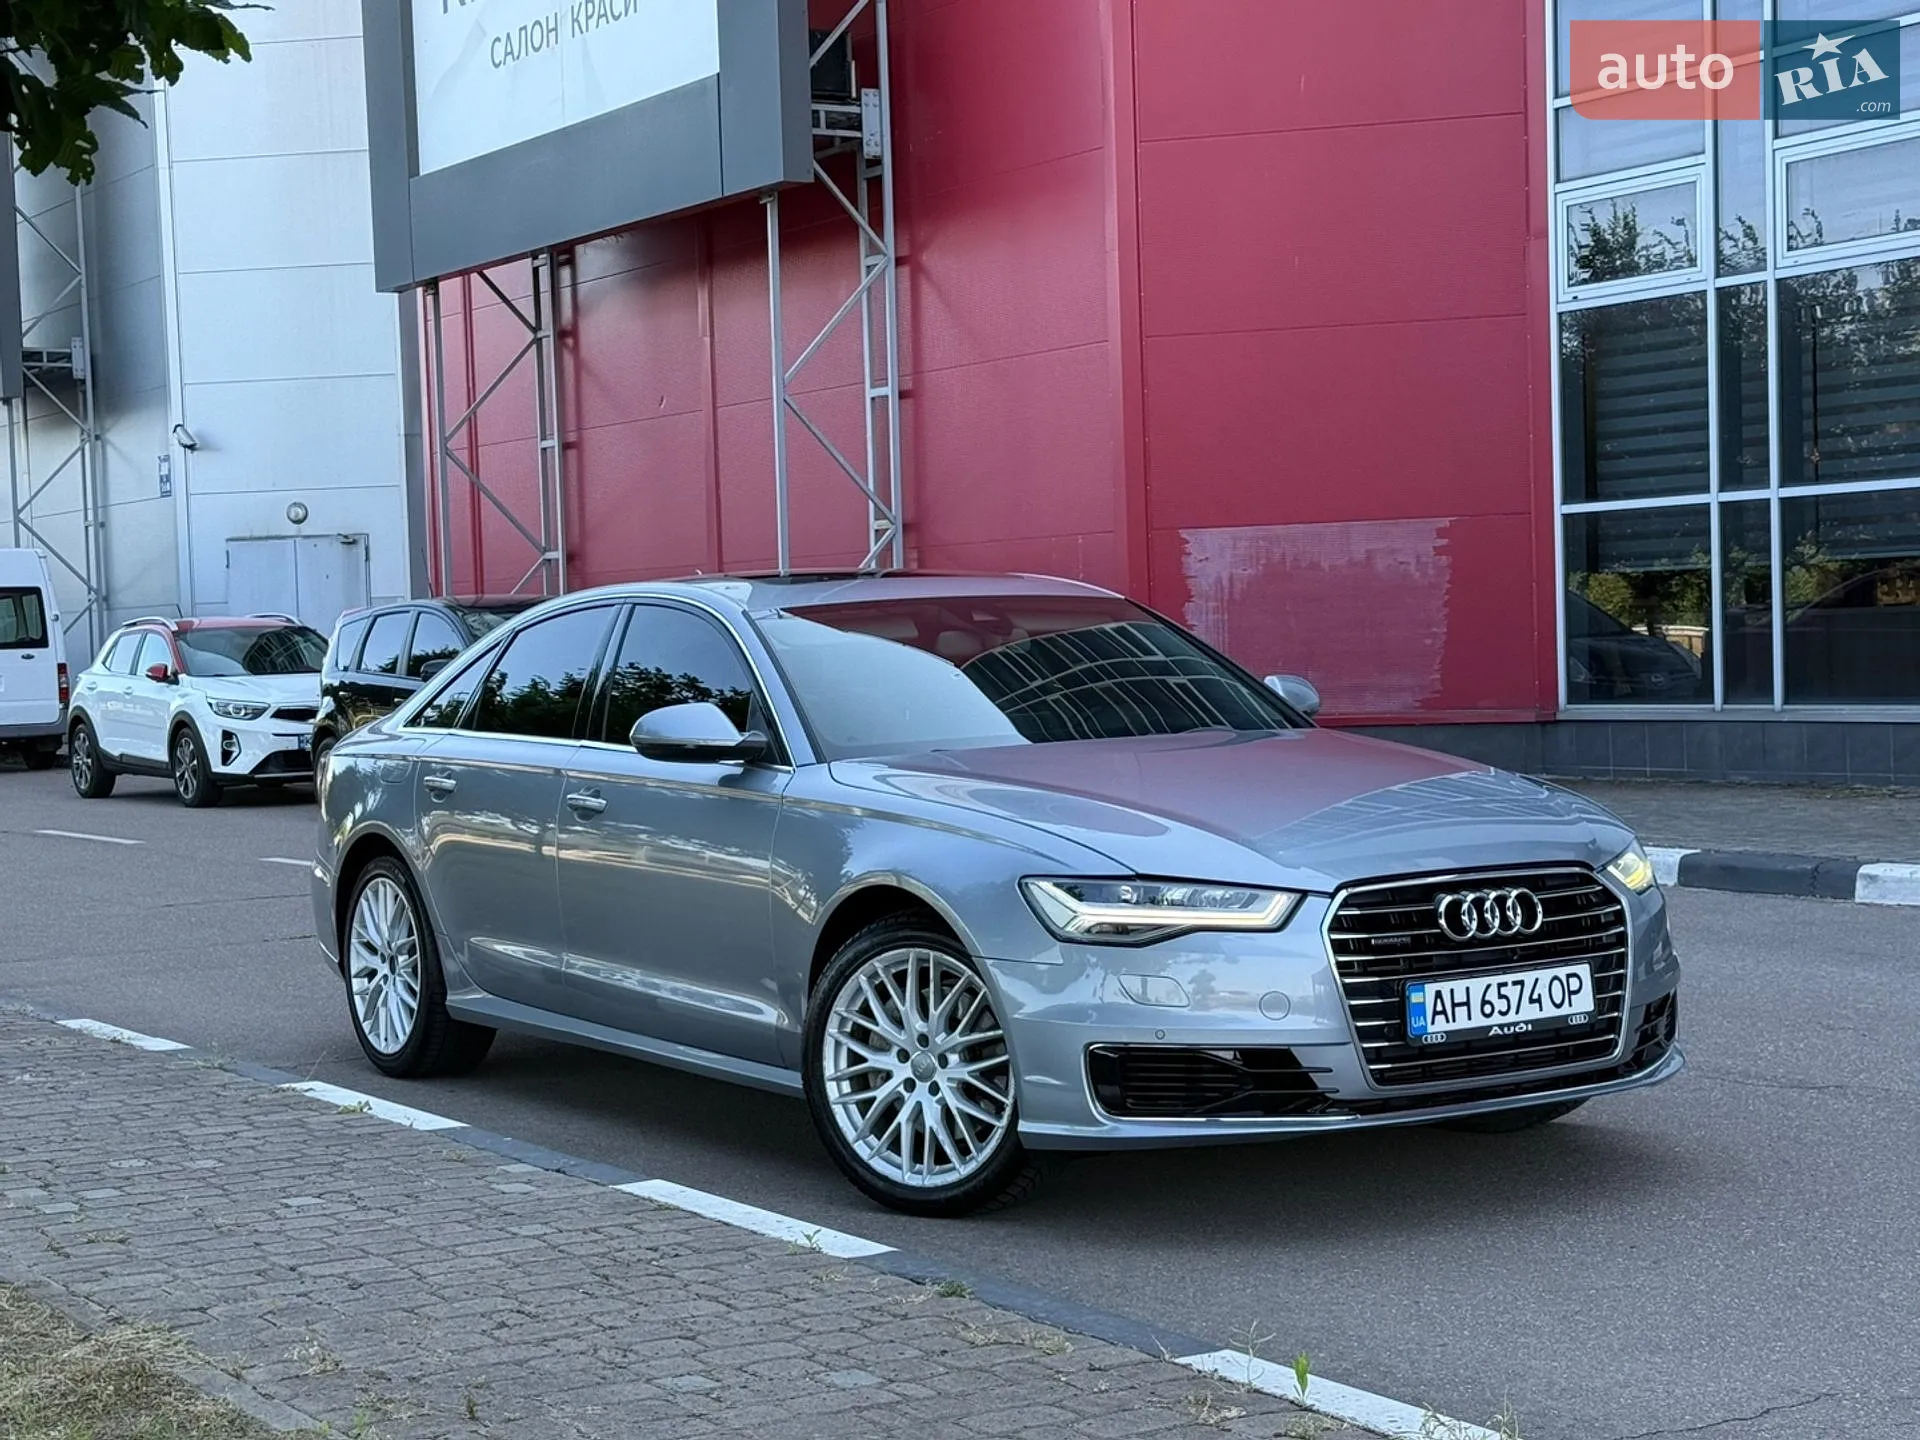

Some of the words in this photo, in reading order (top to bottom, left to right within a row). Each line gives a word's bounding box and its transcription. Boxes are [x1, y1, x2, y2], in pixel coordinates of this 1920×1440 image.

[490, 11, 559, 69] САЛОН
[1430, 986, 1473, 1026] AH
[1480, 977, 1543, 1019] 6574
[1549, 971, 1584, 1010] OP
[1412, 1016, 1427, 1028] UA
[1488, 1023, 1533, 1036] Audi
